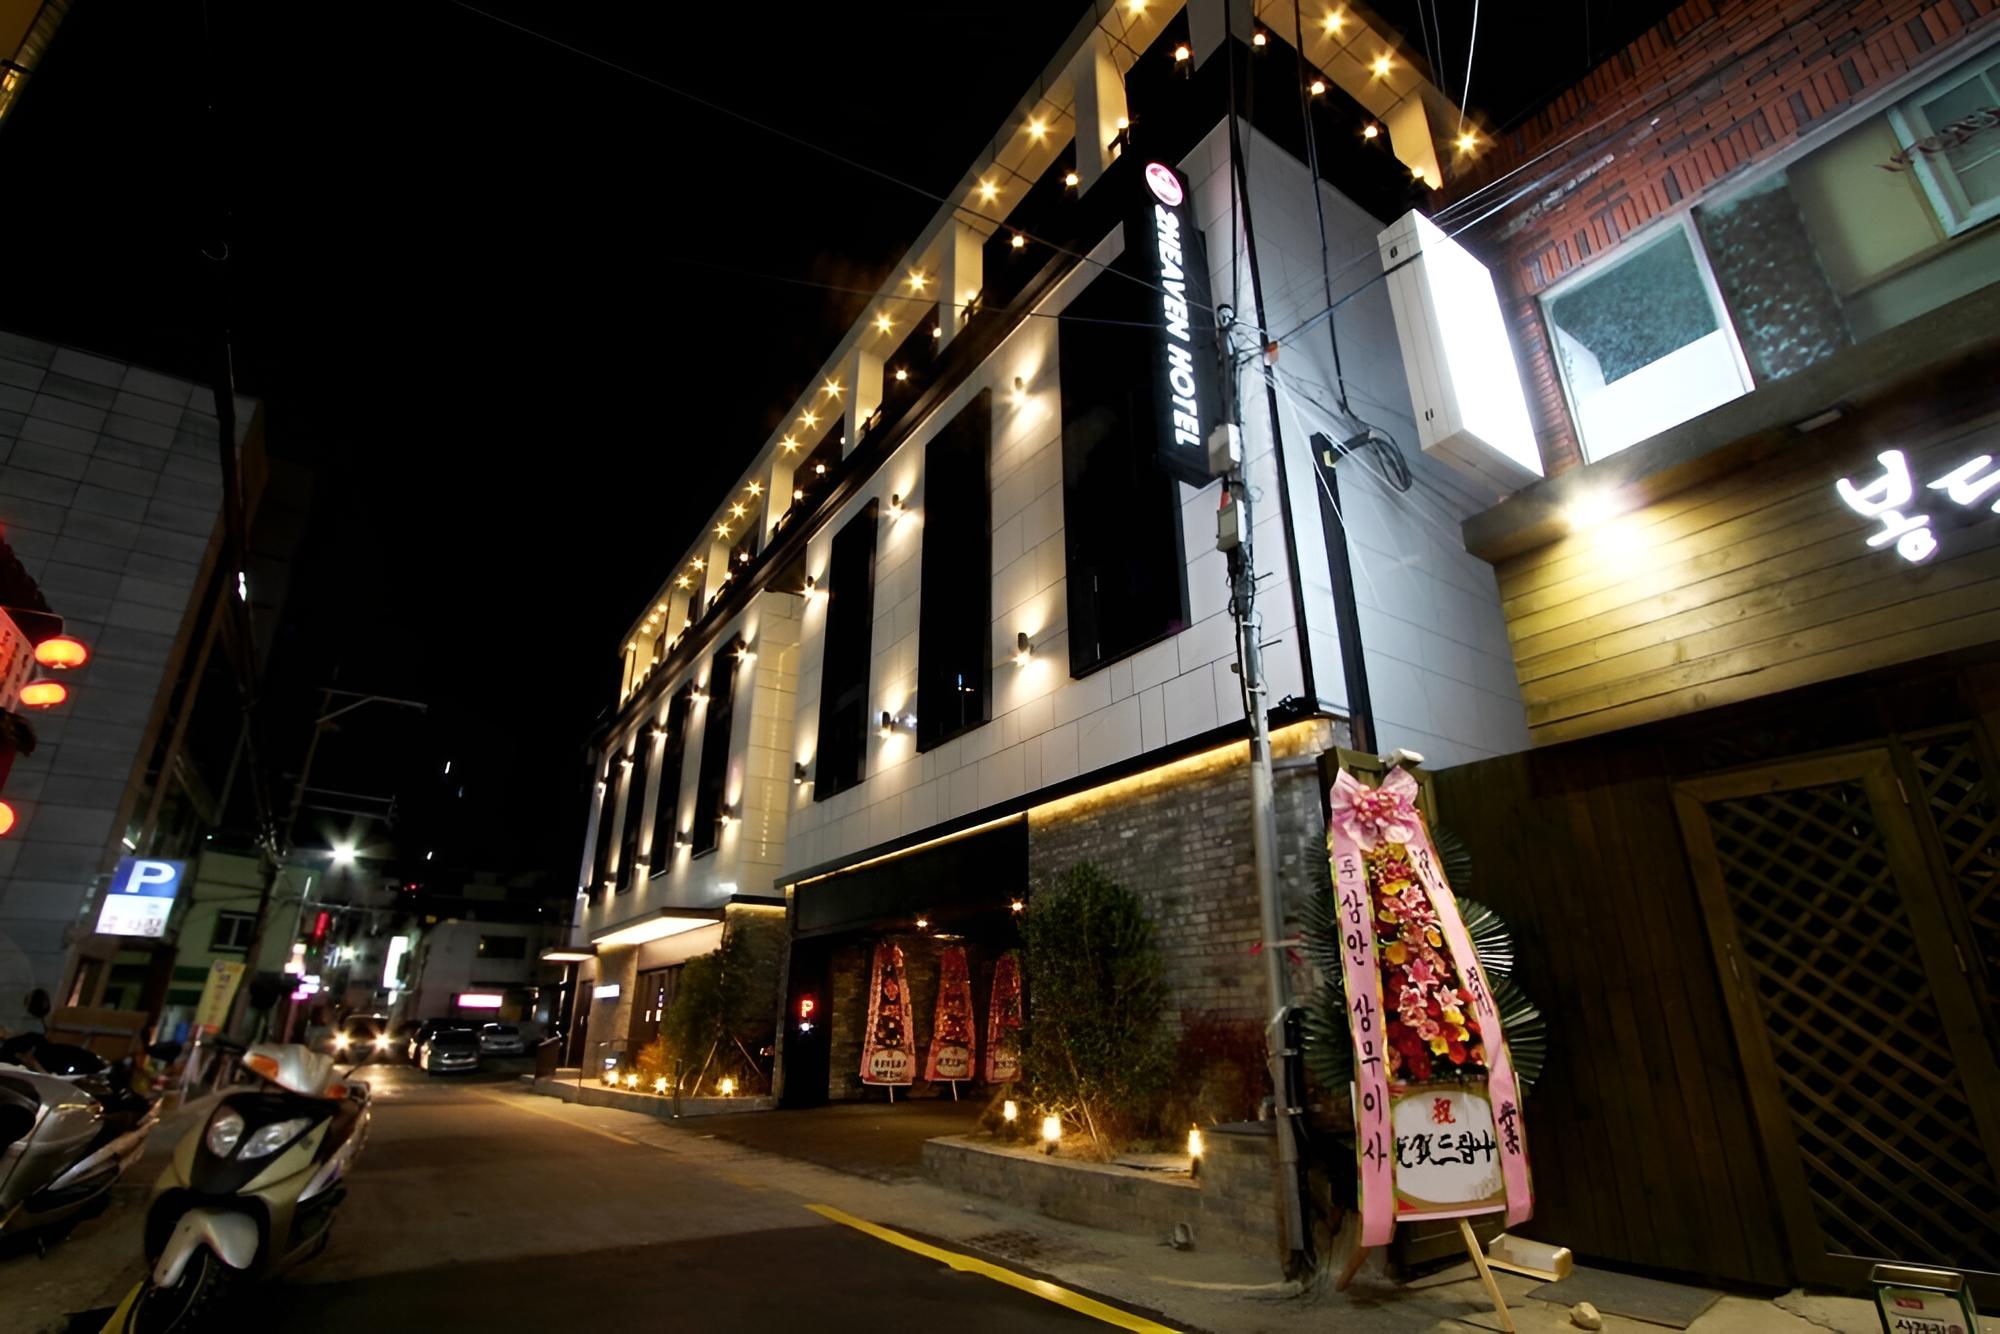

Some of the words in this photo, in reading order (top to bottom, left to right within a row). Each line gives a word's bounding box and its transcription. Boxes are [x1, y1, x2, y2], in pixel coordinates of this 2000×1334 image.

[1167, 342, 1201, 447] HOTEL
[125, 860, 176, 893] P
[801, 999, 814, 1018] P
[1353, 993, 1387, 1172] 상무이사
